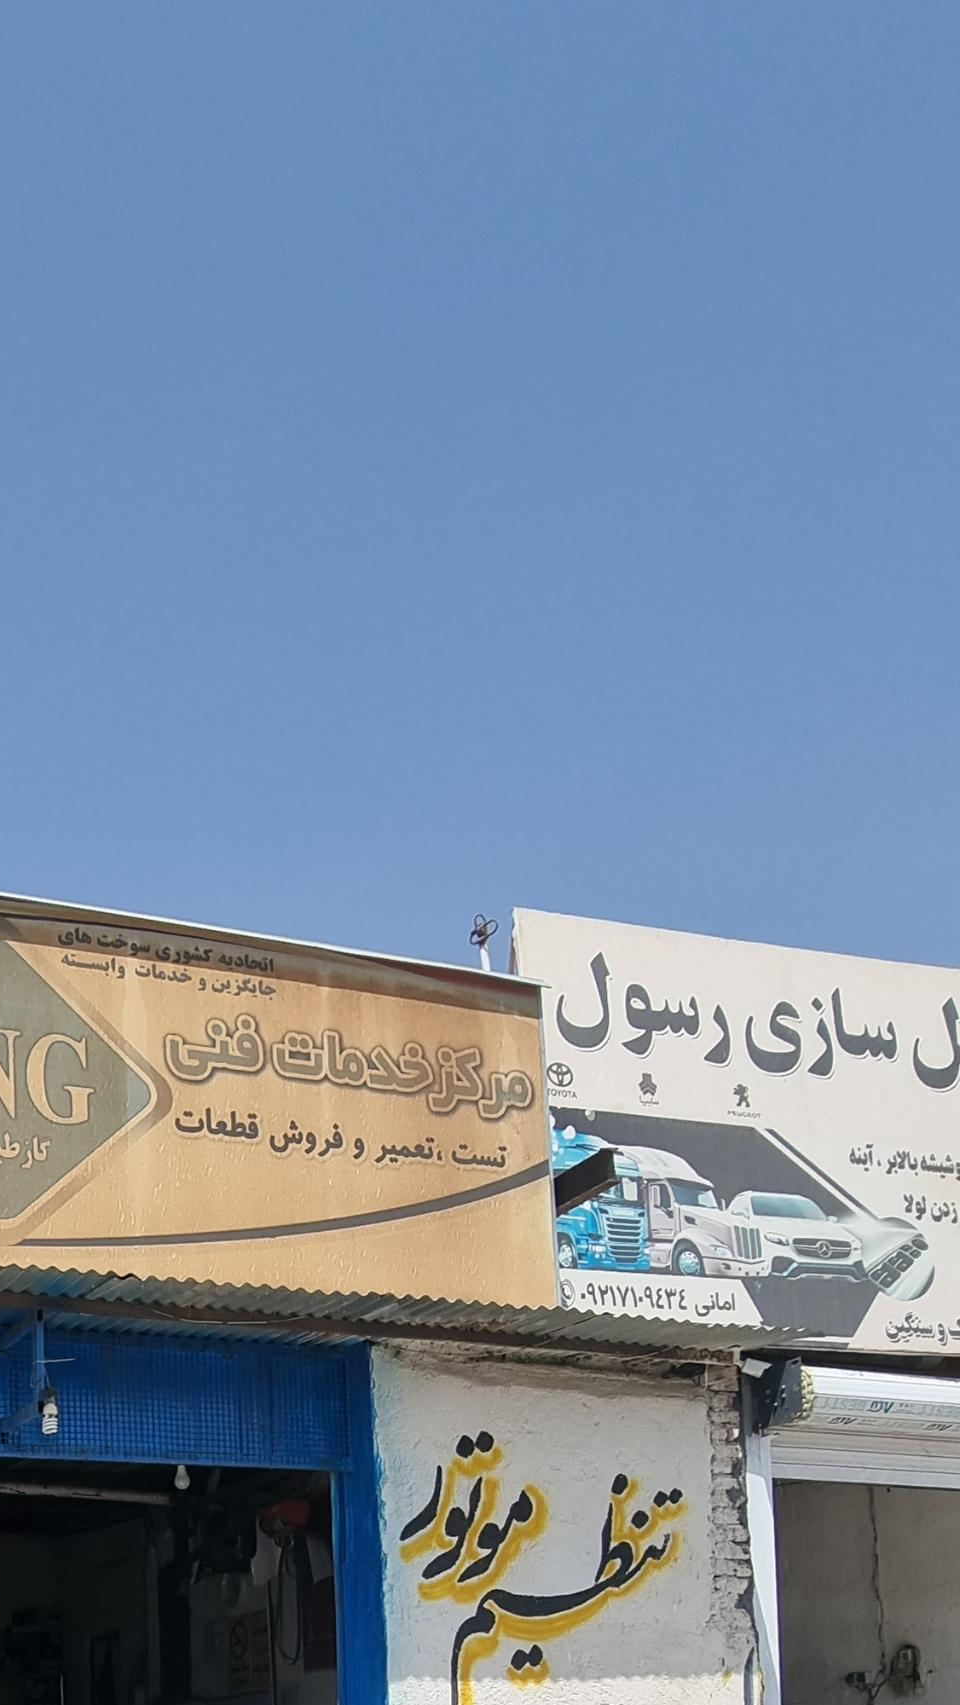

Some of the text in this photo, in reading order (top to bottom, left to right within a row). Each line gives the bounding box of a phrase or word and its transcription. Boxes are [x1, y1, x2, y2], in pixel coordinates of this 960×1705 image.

[58, 927, 274, 973] اتحادیه کشوری سوخت های
[61, 953, 126, 979] وابسته
[135, 963, 192, 984] خدمات
[198, 976, 207, 991] و
[556, 951, 732, 1067] رسول
[745, 987, 898, 1077] سازی
[164, 1013, 534, 1119] مرکز خدمات فنی
[174, 1107, 260, 1140] قطعات
[727, 1110, 761, 1119] PEUGEOT
[269, 1120, 344, 1153] فروش
[353, 1138, 365, 1159] و
[451, 1144, 508, 1169] تست
[849, 1143, 874, 1172] آینه
[903, 1194, 958, 1224] زدن لولا
[695, 1292, 736, 1317] امانی
[885, 1311, 934, 1343] سنگین
[399, 1430, 534, 1582] موتور
